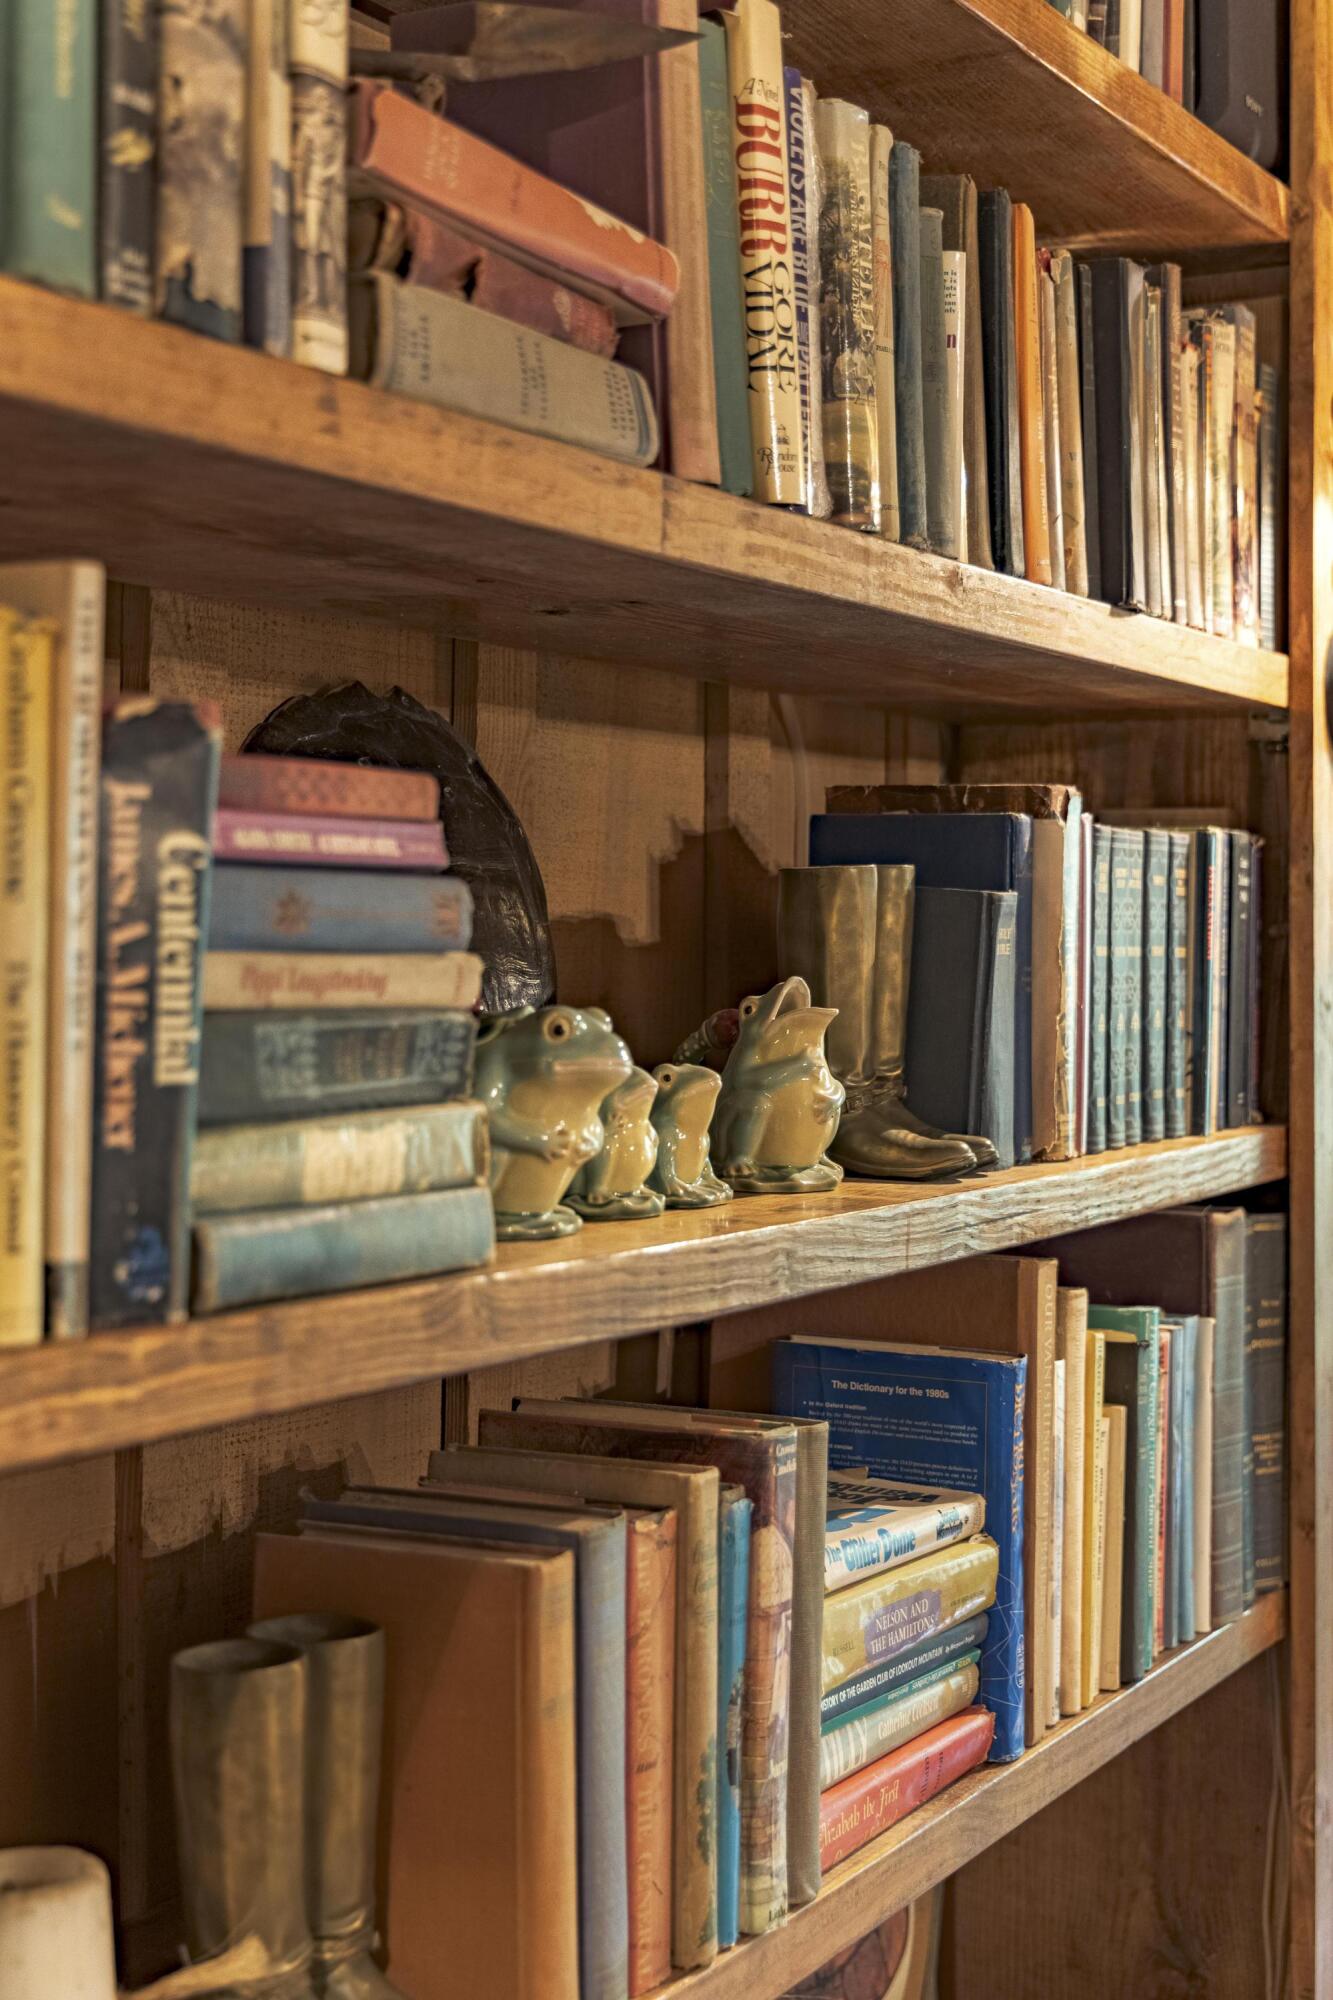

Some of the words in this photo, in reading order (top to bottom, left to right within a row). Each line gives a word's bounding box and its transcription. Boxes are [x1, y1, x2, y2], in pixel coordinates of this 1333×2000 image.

[789, 86, 805, 190] VIOLETS
[735, 103, 787, 257] BURR
[791, 198, 808, 249] ARE
[744, 261, 777, 393] VIDAL
[773, 261, 798, 393] GORE
[757, 447, 796, 465] Random
[765, 460, 796, 476] House
[154, 829, 210, 1088] Centennial
[1044, 1284, 1054, 1330] OUR
[831, 1379, 848, 1391] The
[849, 1381, 893, 1396] Dictionary
[895, 1385, 908, 1395] for
[909, 1387, 922, 1397] the
[925, 1388, 949, 1399] 1980s
[826, 1544, 842, 1566] The
[840, 1536, 881, 1572] Glitter
[877, 1527, 916, 1563] Dome
[870, 1635, 887, 1656] THE
[888, 1614, 936, 1647] HAMILTONS
[875, 1607, 908, 1633] NELSON
[911, 1598, 929, 1617] AND
[839, 1691, 849, 1703] OF
[849, 1687, 859, 1700] THE
[856, 1677, 877, 1696] GARDEN
[877, 1671, 888, 1686] CLUB
[888, 1668, 896, 1680] OF
[896, 1657, 919, 1677] LOOKOUT
[918, 1646, 943, 1666] MOUNTAIN
[878, 1712, 910, 1740] Catherine
[911, 1694, 940, 1722] Cookson
[863, 1796, 875, 1821] the
[876, 1779, 900, 1817] First
